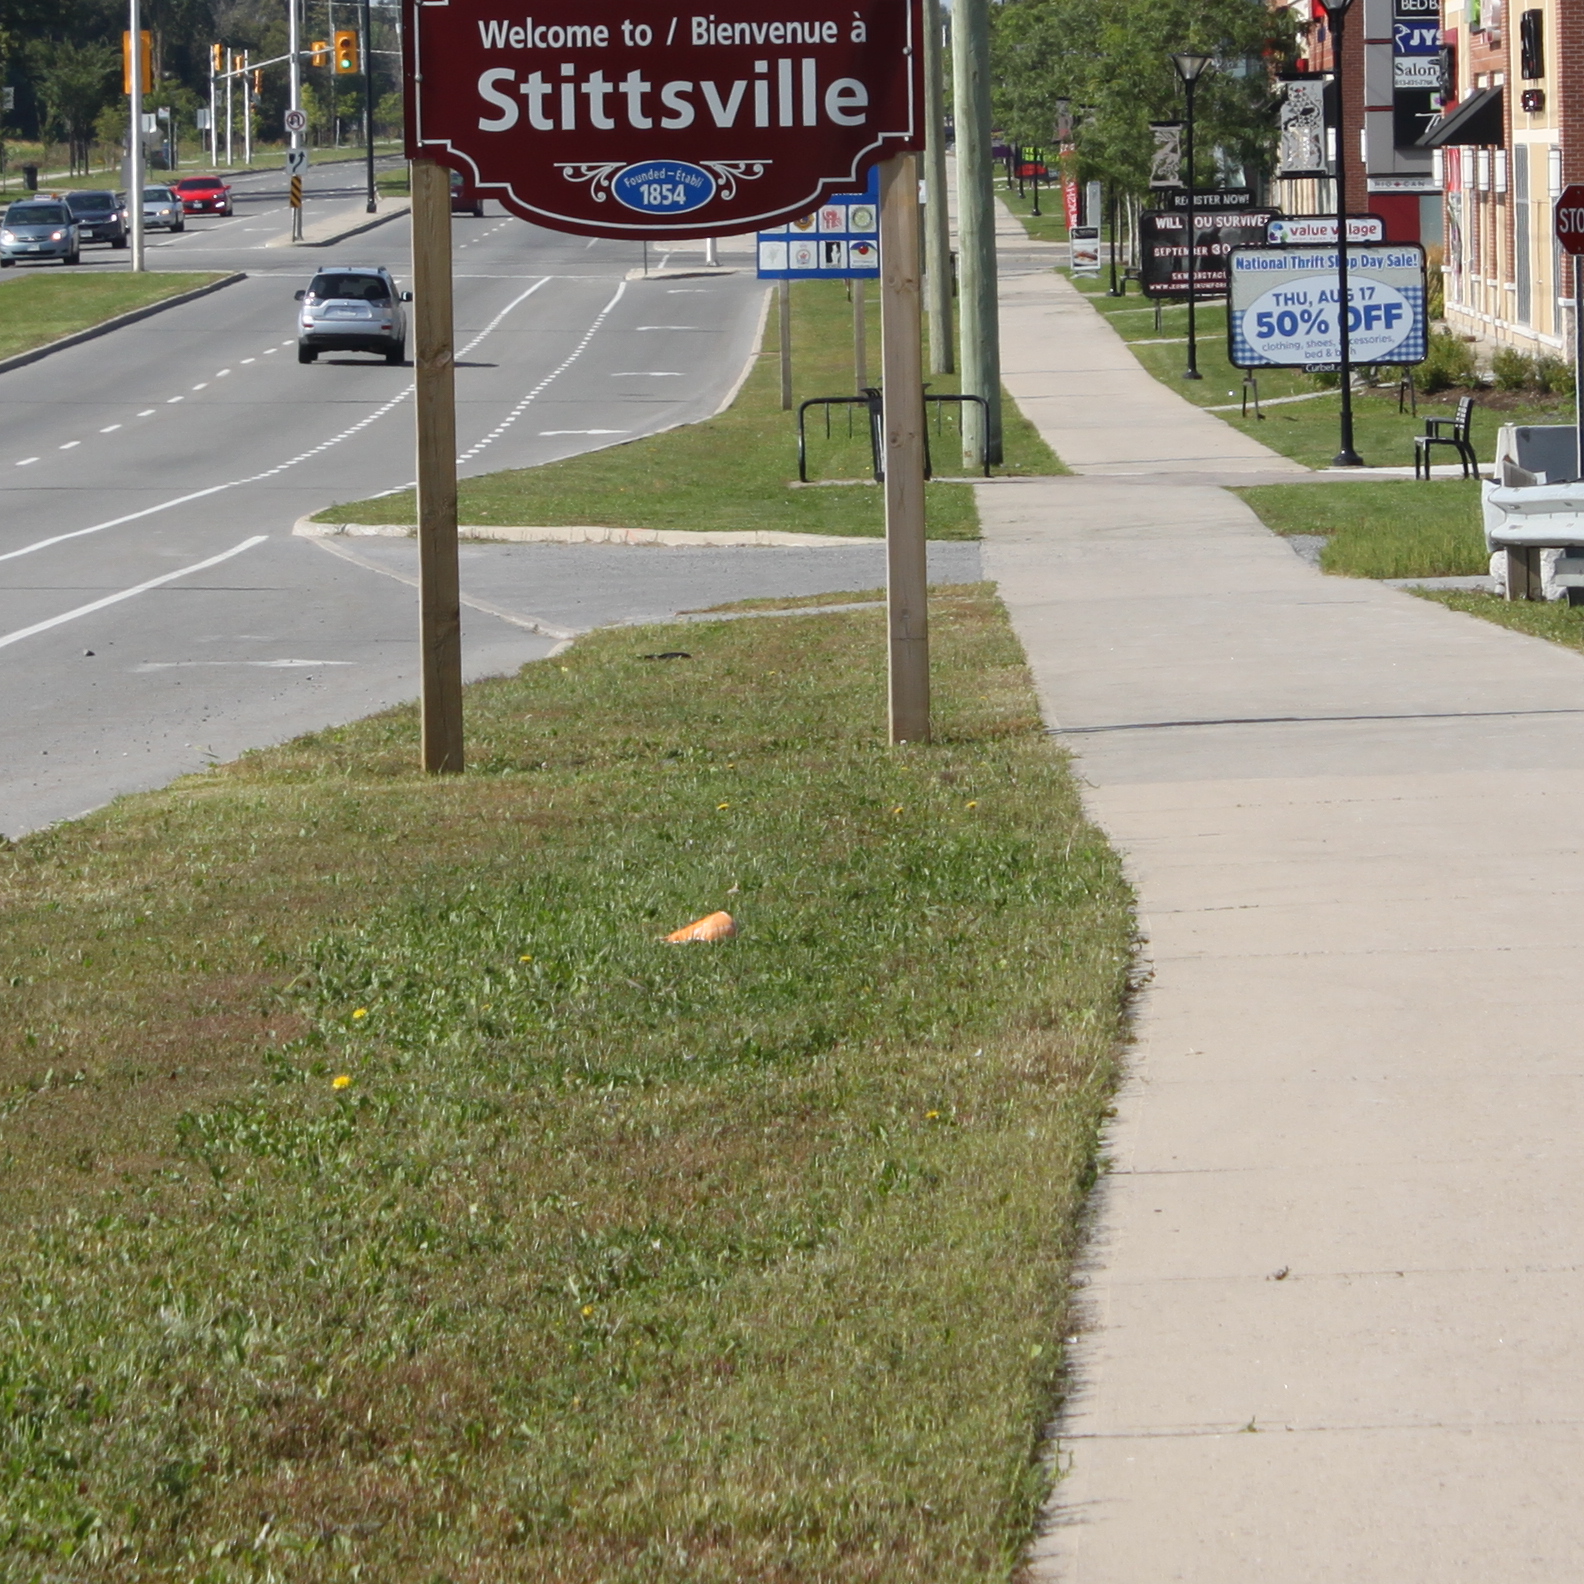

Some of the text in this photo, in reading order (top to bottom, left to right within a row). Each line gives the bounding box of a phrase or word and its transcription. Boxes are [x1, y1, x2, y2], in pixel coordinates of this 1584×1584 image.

[478, 17, 609, 49] Welcome
[621, 18, 653, 47] to
[691, 14, 838, 45] Bienvenue
[850, 11, 867, 43] à
[1394, 62, 1437, 76] Salon
[477, 57, 869, 132] Stittsville
[623, 168, 666, 188] Founded
[676, 167, 704, 188] Établi
[639, 184, 687, 205] 1854
[1175, 194, 1250, 206] REISTER NOW!
[1155, 216, 1183, 229] WILL
[1190, 216, 1213, 228] OU
[1290, 224, 1377, 236] value vlage
[1236, 256, 1287, 270] National
[1291, 255, 1324, 269] Thrift
[1361, 254, 1383, 269] Day
[1387, 253, 1418, 267] Sale!
[1272, 291, 1313, 307] THU,
[1359, 286, 1376, 301] 17
[1256, 302, 1403, 339] 50% OFF
[1262, 334, 1395, 353] clothing, shoes, cessories,
[1305, 348, 1323, 358] bed
[1335, 346, 1357, 357] bh
